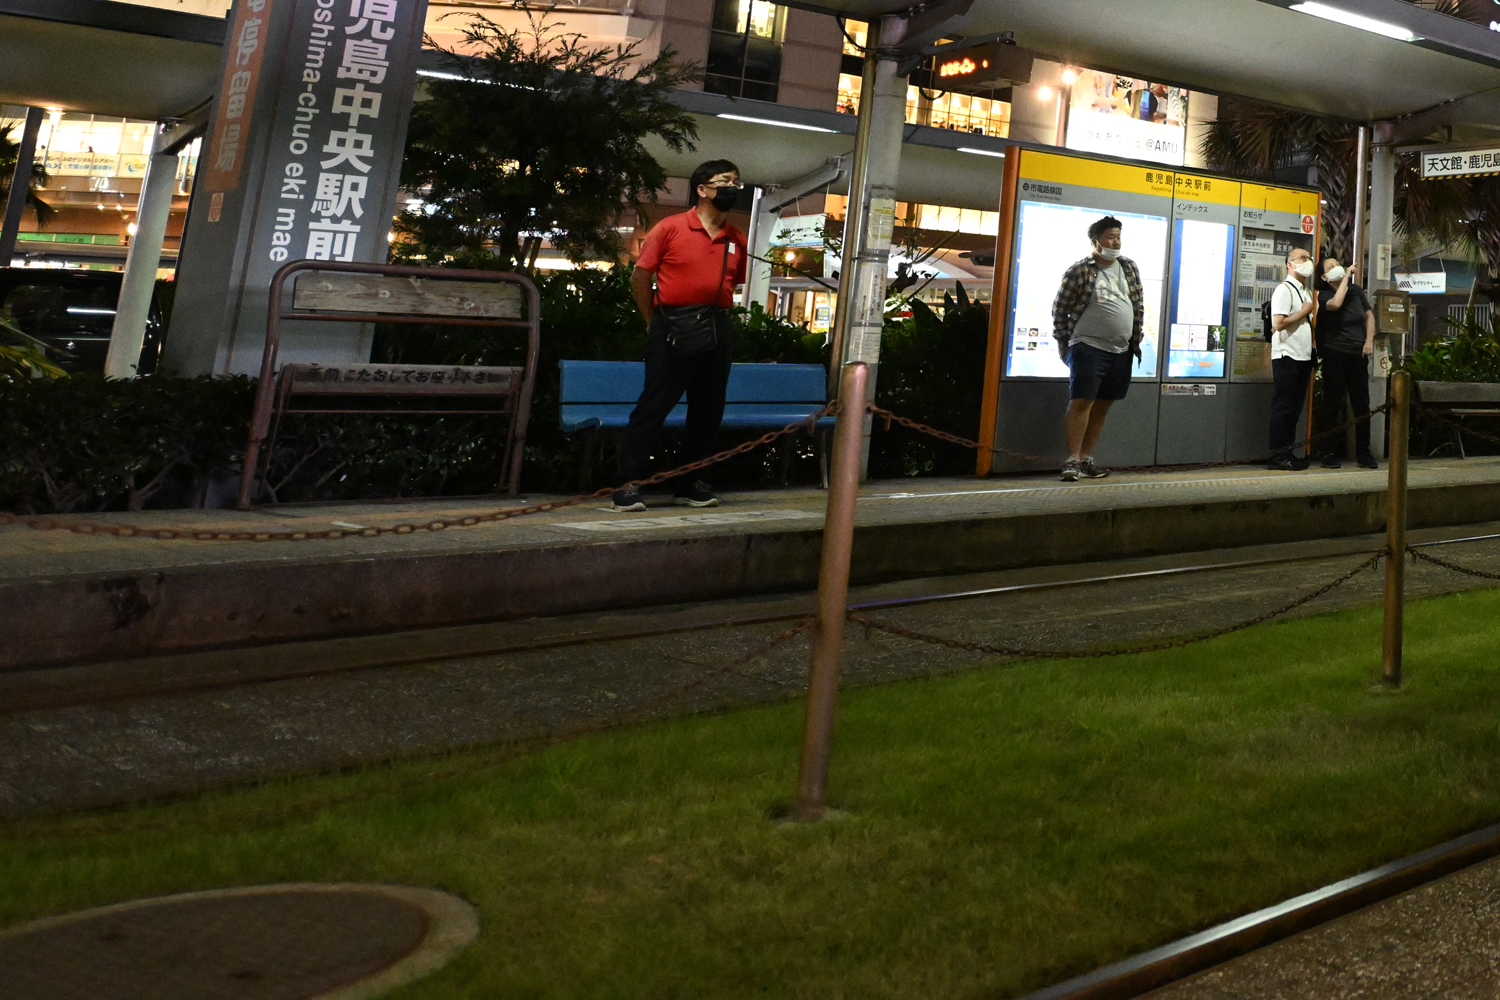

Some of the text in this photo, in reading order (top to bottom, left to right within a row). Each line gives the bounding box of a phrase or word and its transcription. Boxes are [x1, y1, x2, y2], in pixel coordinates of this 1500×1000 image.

[1145, 138, 1178, 154] @AMU
[281, 161, 307, 200] eki
[1146, 172, 1212, 191] 鹿児島中央駅前
[1030, 183, 1062, 196] 市電路線図
[1176, 203, 1208, 213] インデックス
[1243, 210, 1263, 220] お知らせ
[269, 207, 296, 263] mae
[1305, 224, 1311, 232] 11
